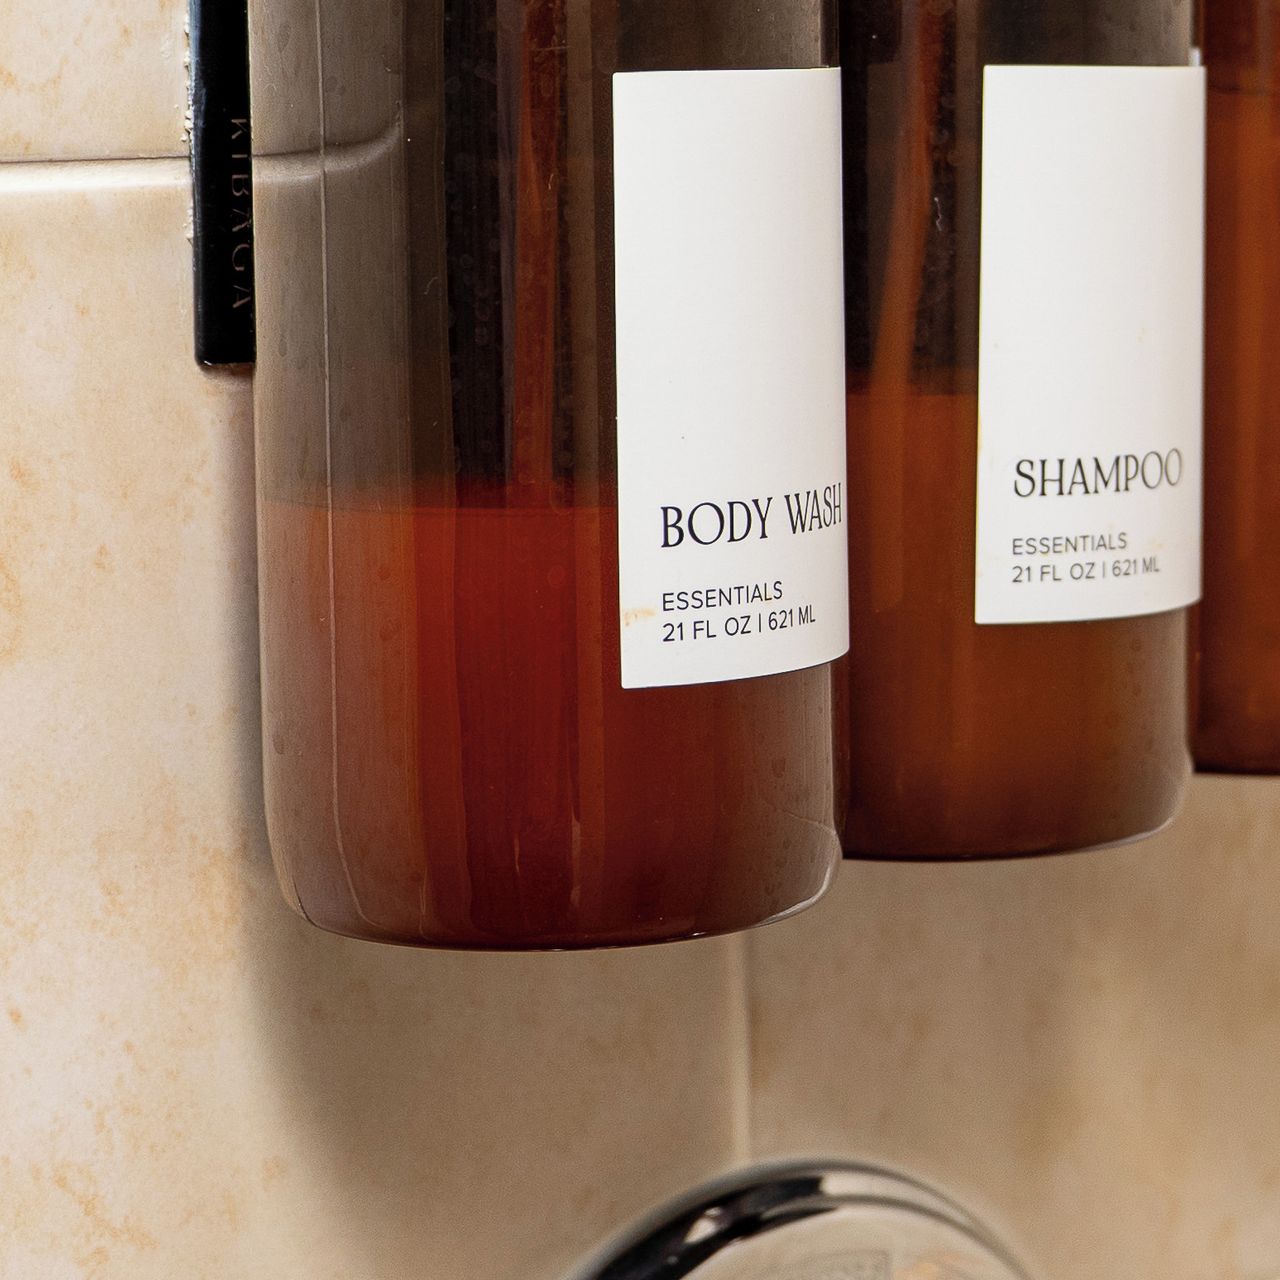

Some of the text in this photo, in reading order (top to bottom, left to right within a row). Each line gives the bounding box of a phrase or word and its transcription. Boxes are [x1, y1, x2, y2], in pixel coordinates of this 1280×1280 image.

[1014, 447, 1184, 498] SHAMPOO
[661, 482, 842, 548] BODY WASH
[1012, 532, 1127, 555] ESSENTIALS
[1012, 566, 1031, 583] 21
[1040, 565, 1062, 581] FL
[1070, 562, 1095, 580] OZ
[1112, 559, 1137, 577] 621
[1143, 557, 1160, 572] ML
[662, 580, 783, 611] ESSENTIALS
[663, 622, 683, 642] 21
[694, 620, 717, 639] FL
[725, 615, 751, 636] OZ
[769, 609, 793, 630] 621
[799, 604, 816, 625] ML
